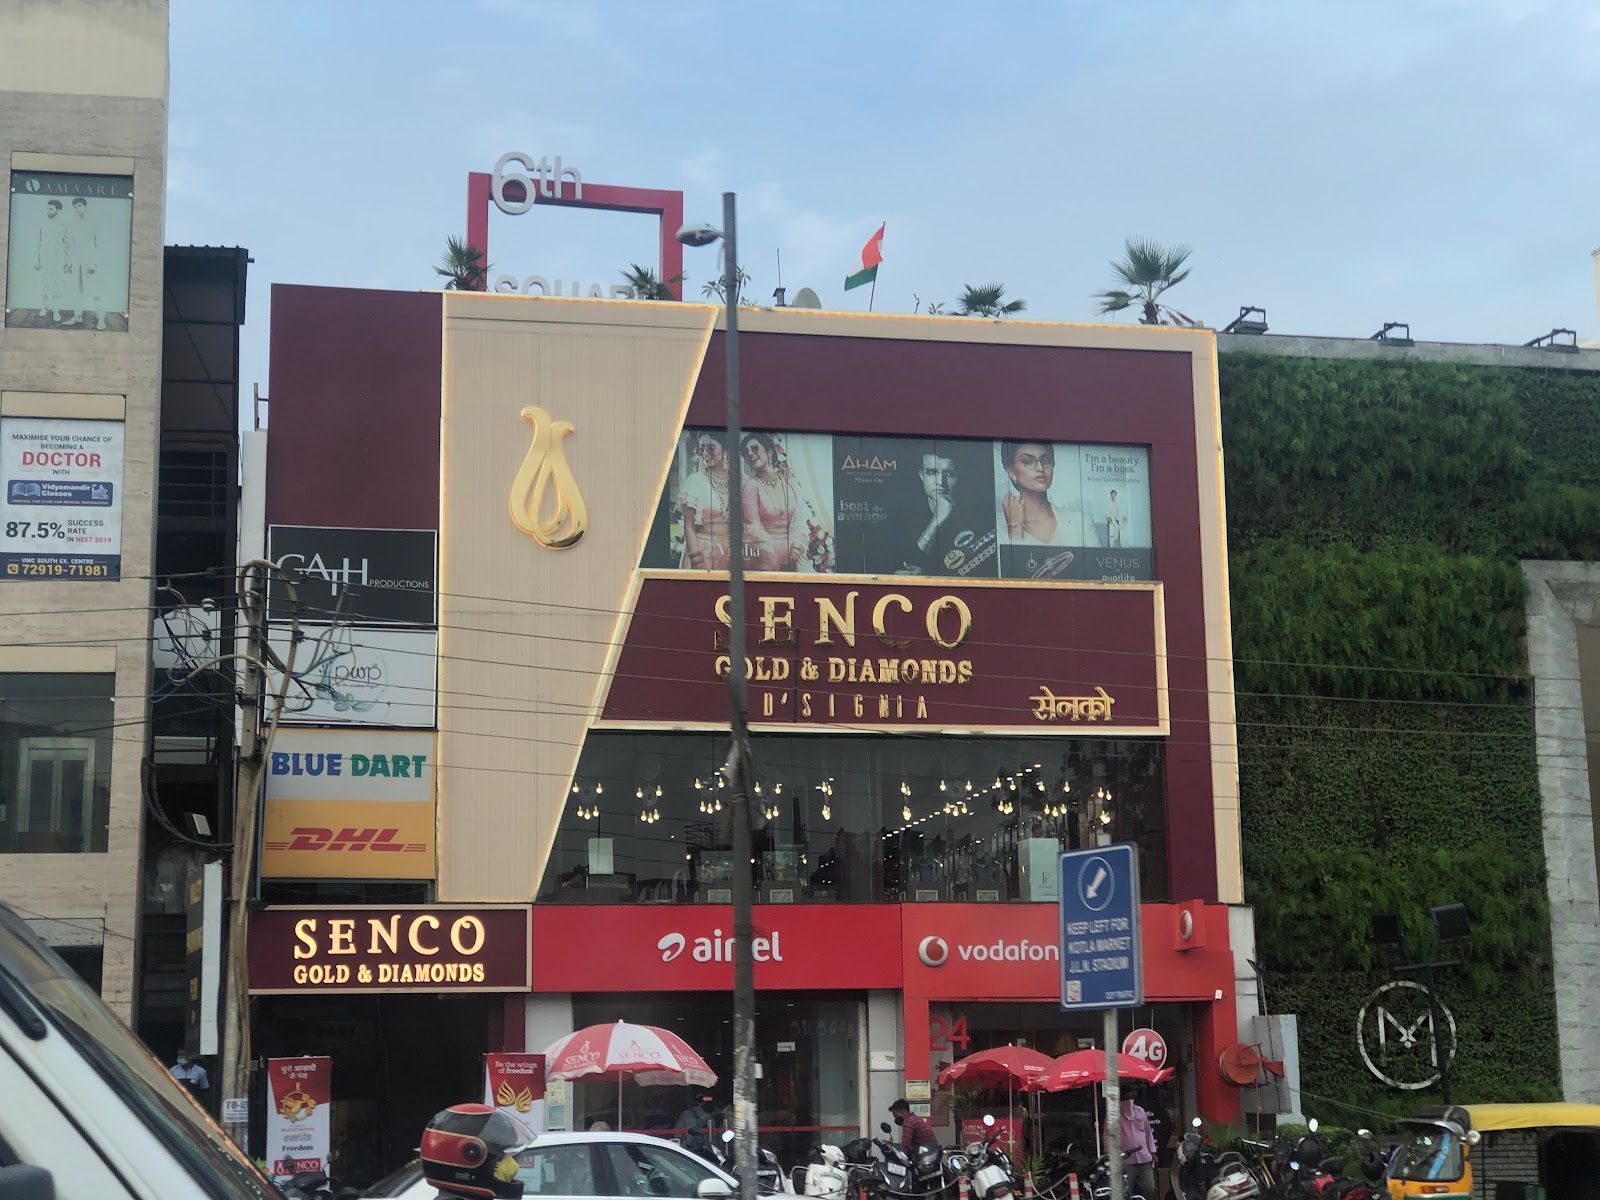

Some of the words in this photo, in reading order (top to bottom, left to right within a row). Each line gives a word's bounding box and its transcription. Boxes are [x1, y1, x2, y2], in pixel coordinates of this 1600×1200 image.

[491, 151, 583, 215] 6th
[22, 451, 101, 467] DOCTOR
[841, 455, 897, 472] AHAM
[1085, 453, 1099, 463] I'm
[1108, 454, 1141, 465] beauty.
[1090, 463, 1105, 472] I'm
[42, 483, 91, 492] Vidyamandir
[5, 521, 65, 539] 87.5%
[21, 564, 108, 576] 72919-71981
[1096, 557, 1140, 568] VENUS
[369, 579, 430, 589] PRODUCTIONS
[799, 656, 820, 681] &
[827, 656, 973, 685] DIAMONDS
[1029, 685, 1115, 721] सेनको
[271, 752, 342, 776] BLUE
[351, 754, 427, 778] DART
[288, 827, 405, 852] DHL
[1067, 921, 1089, 935] KEEP
[1089, 919, 1110, 933] LEFT
[293, 914, 485, 960] SENCO
[692, 929, 783, 962] airel
[957, 939, 1060, 961] vodafon
[293, 964, 350, 984] GOLD
[357, 964, 373, 983] &
[378, 963, 485, 983] DIAMONDS
[619, 1051, 661, 1060] SENCO
[1129, 1035, 1162, 1061] 4G
[563, 1051, 600, 1067] SENCO
[281, 1144, 314, 1152] Freedom
